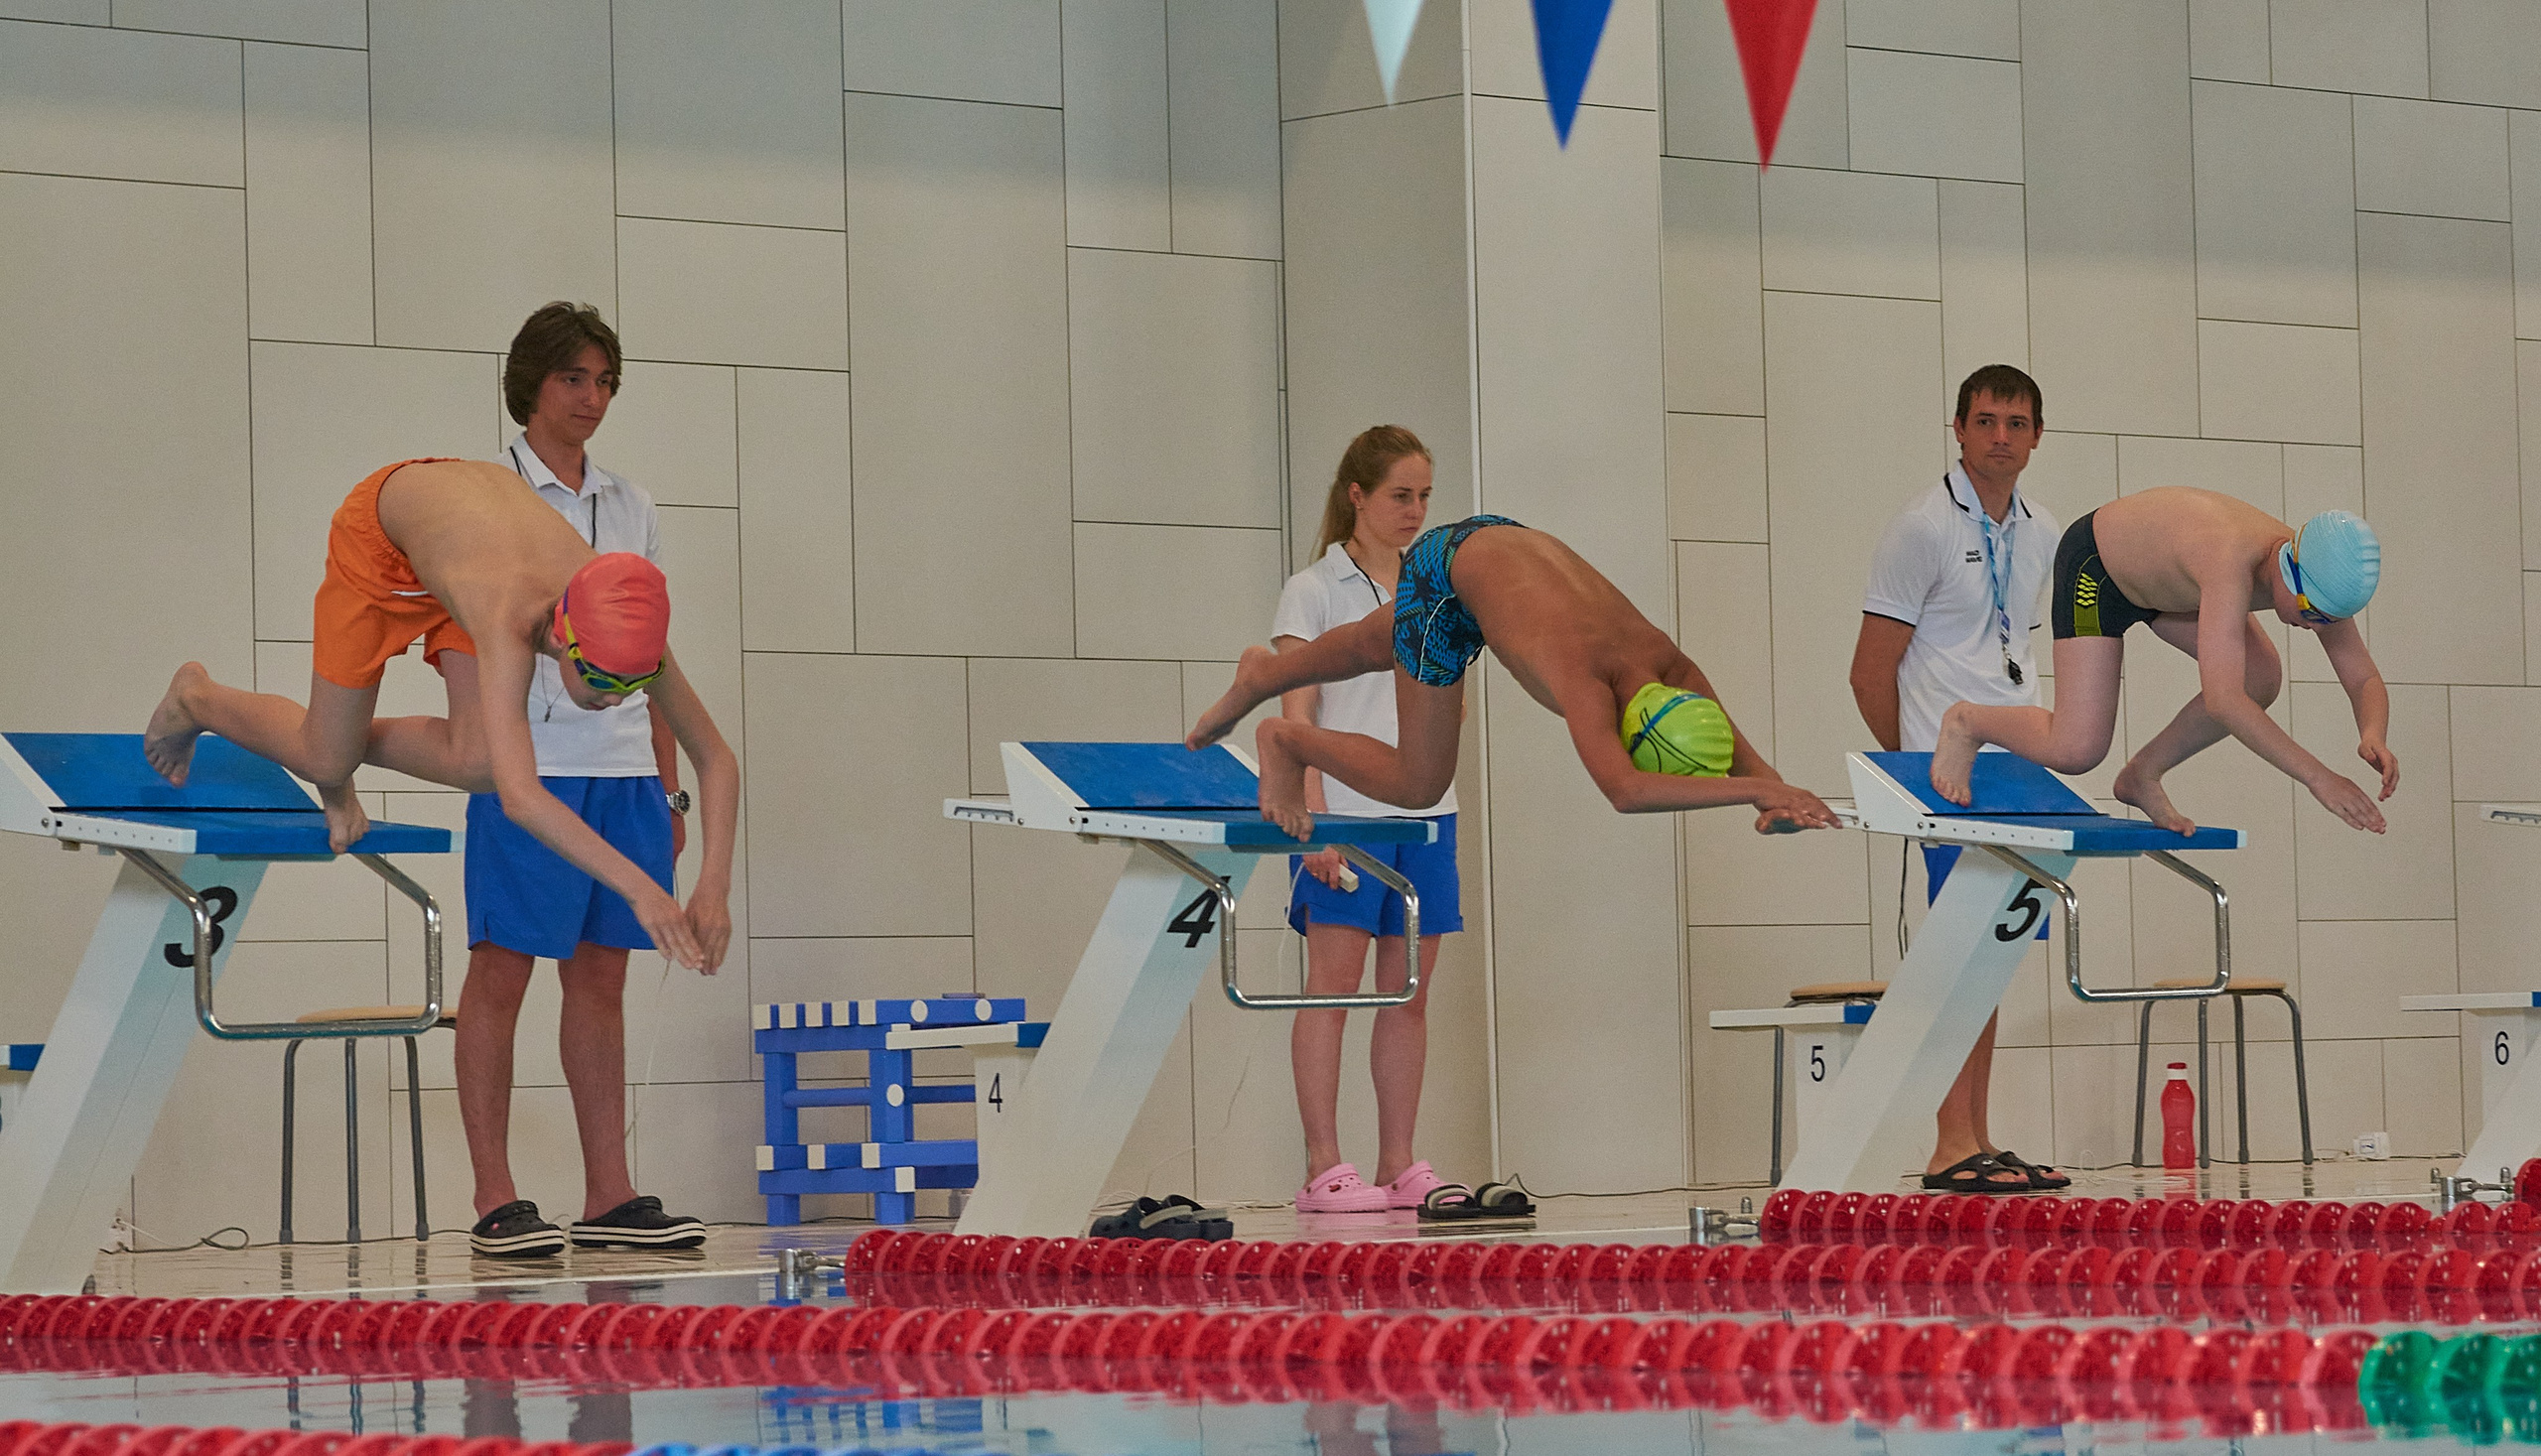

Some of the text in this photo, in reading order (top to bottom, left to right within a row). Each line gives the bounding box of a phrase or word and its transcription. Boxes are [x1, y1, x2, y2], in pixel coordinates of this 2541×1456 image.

[164, 885, 238, 969] 3
[1166, 875, 1232, 948] 4
[1995, 877, 2047, 942] 5
[1810, 1045, 1825, 1082] 5
[2494, 1030, 2509, 1065] 6
[988, 1072, 1003, 1113] 4
